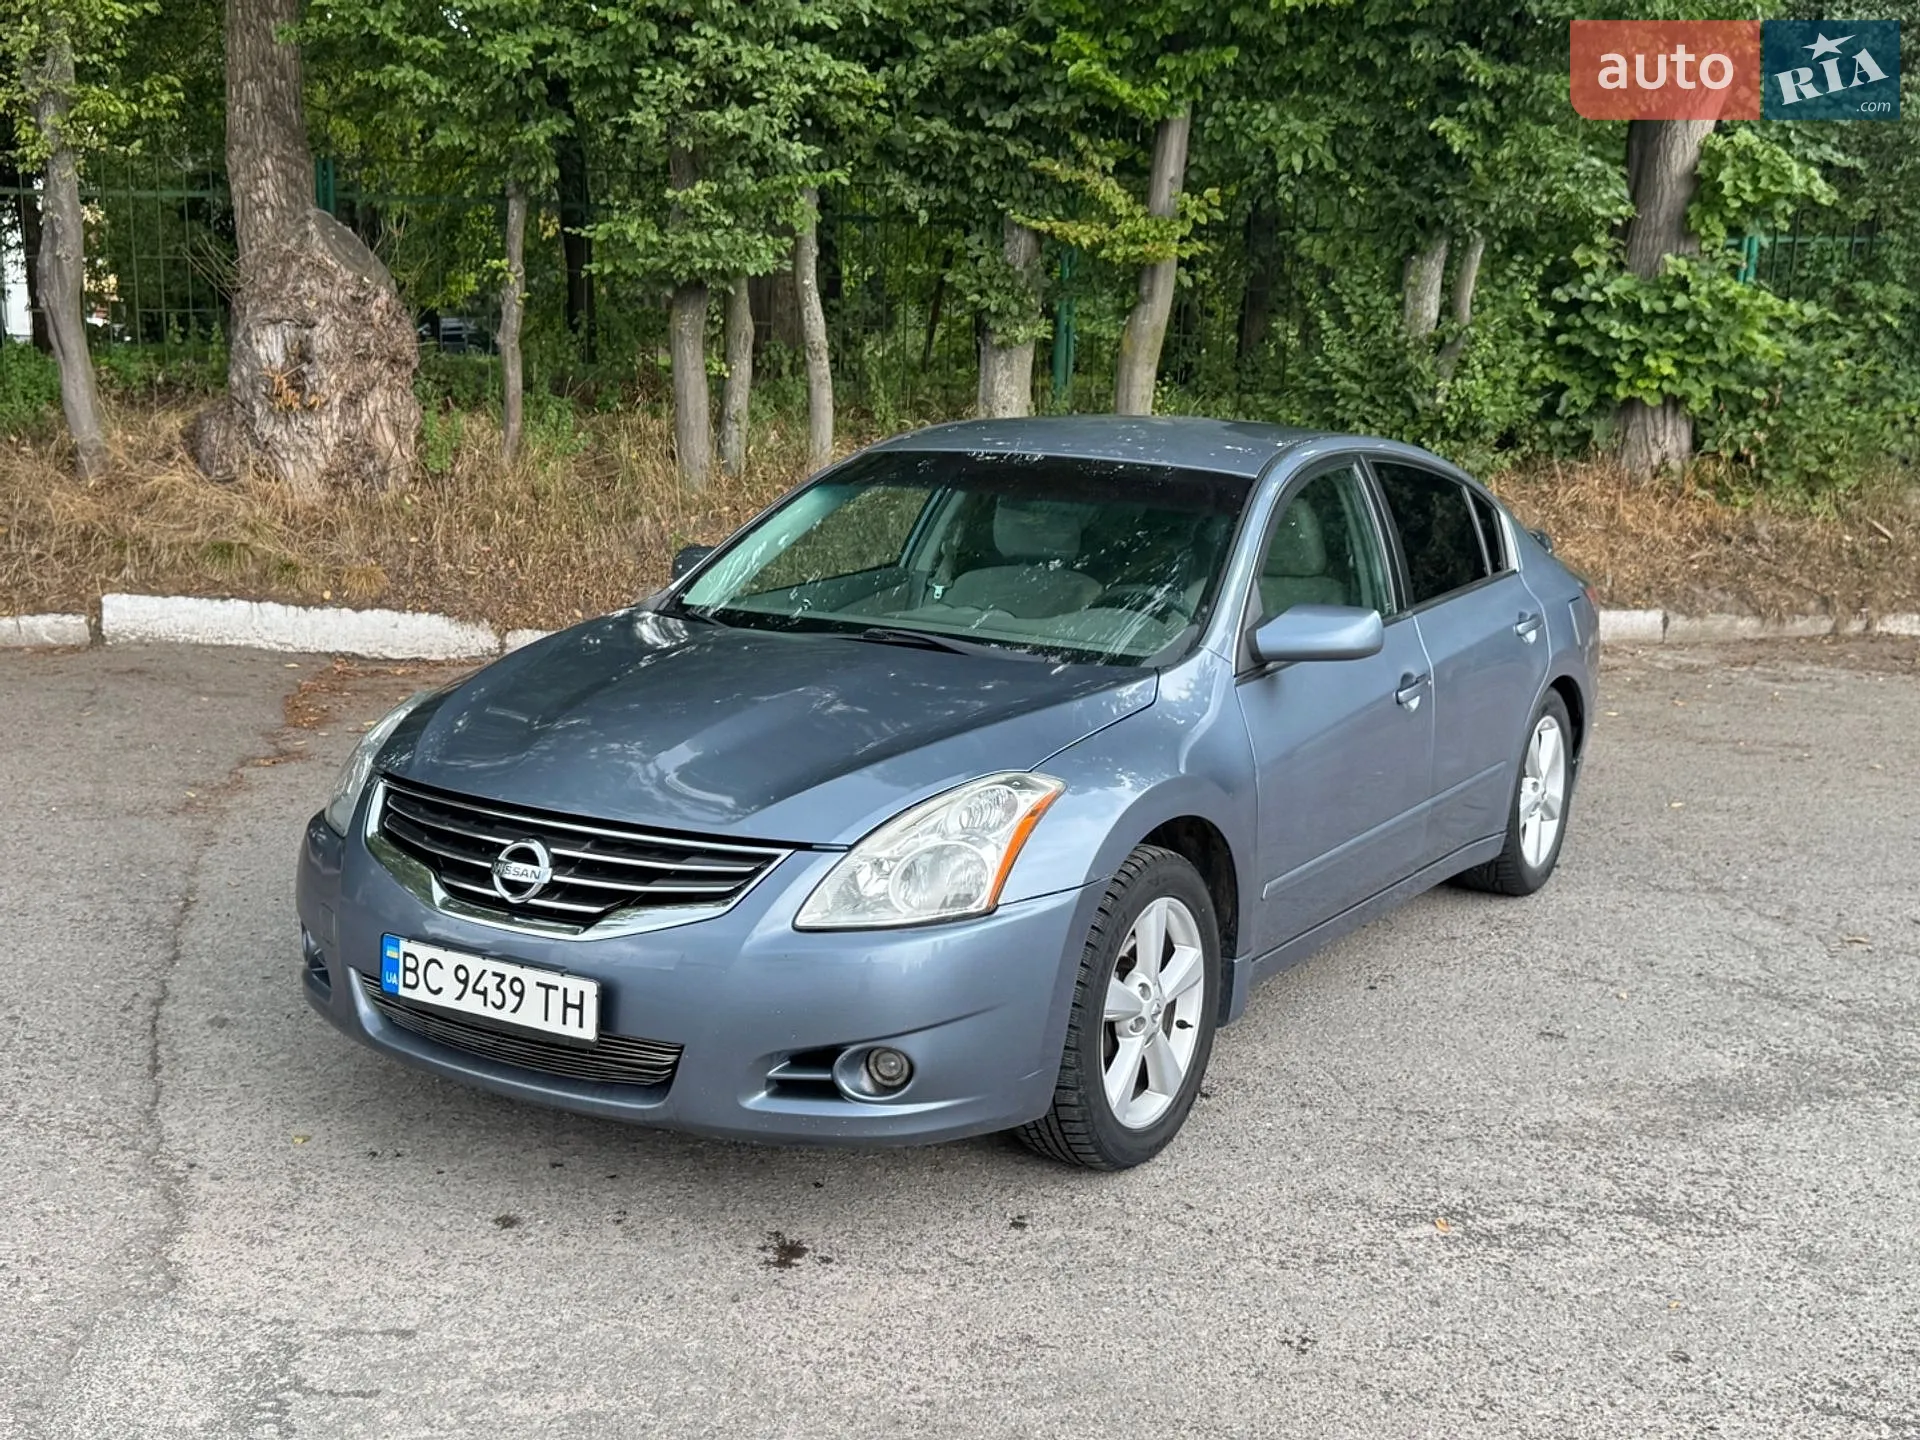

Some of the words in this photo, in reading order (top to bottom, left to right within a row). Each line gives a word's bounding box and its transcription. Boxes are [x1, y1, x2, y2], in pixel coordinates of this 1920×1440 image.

[494, 860, 541, 880] NISSAN
[386, 971, 398, 986] UA
[403, 951, 444, 995] BC
[454, 964, 525, 1014] 9439
[536, 981, 584, 1028] TH
